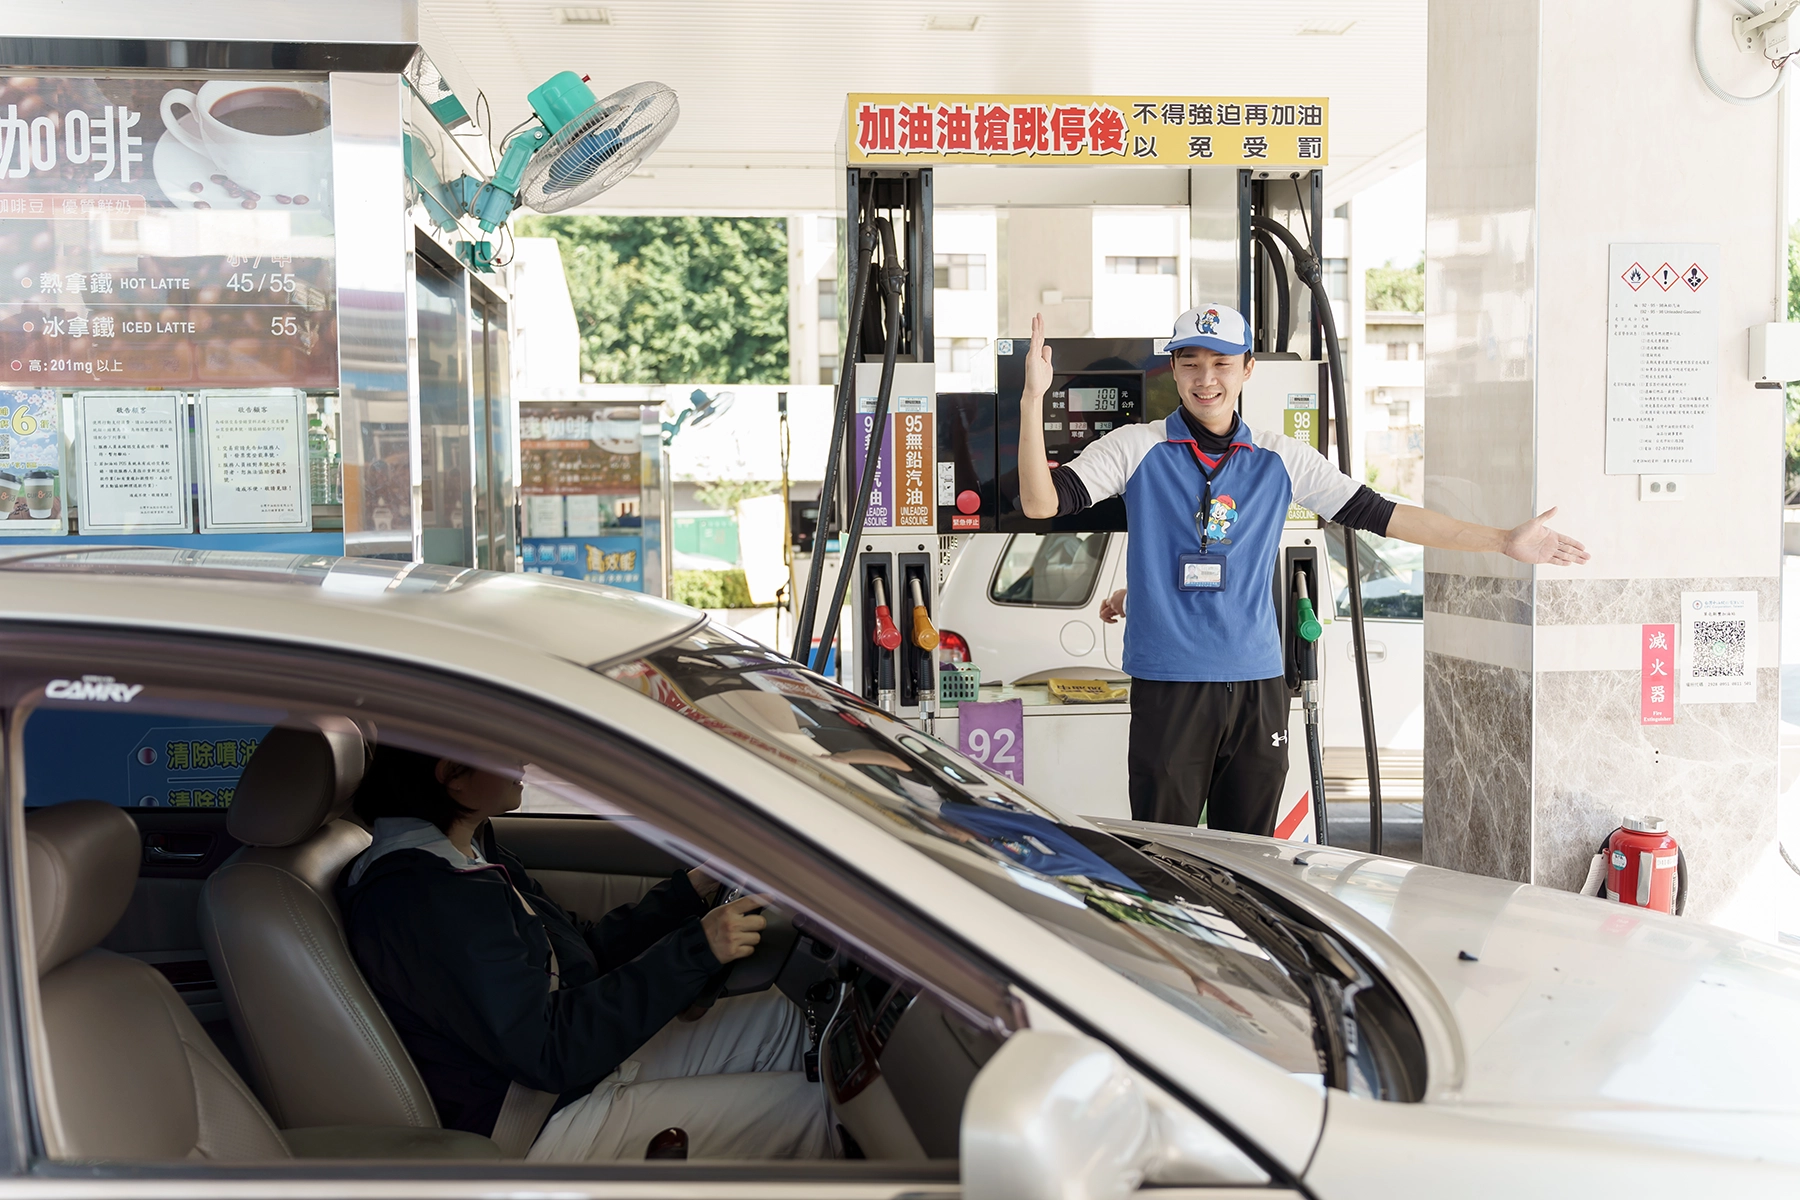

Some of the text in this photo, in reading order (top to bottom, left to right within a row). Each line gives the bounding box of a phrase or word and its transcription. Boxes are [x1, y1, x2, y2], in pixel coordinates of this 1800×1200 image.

[1133, 103, 1322, 126] 不得強迫再加油
[859, 104, 1125, 153] 加油油槍跳停後
[61, 198, 132, 215] 優質鮮奶
[39, 272, 114, 294] 熱拿鐵
[120, 277, 147, 290] HOT
[151, 277, 190, 290] LATTE
[42, 315, 298, 338] 冰拿鐵 ICED LATTE 55
[96, 359, 123, 373] 以上
[1097, 388, 1116, 400] 100
[1094, 399, 1116, 411] 3.04
[1121, 401, 1135, 409] 公升
[12, 405, 38, 436] 6
[905, 415, 923, 432] 95
[1294, 411, 1311, 429] 98
[905, 433, 923, 505] 無鉛汽油
[900, 506, 928, 516] UNLEADED
[864, 517, 888, 526] ASOLINE
[900, 517, 928, 526] GASOLINE
[953, 517, 980, 527] 緊急停止
[1648, 631, 1668, 703] 滅火器
[44, 679, 145, 703] CAMRY
[968, 728, 1016, 764] 92
